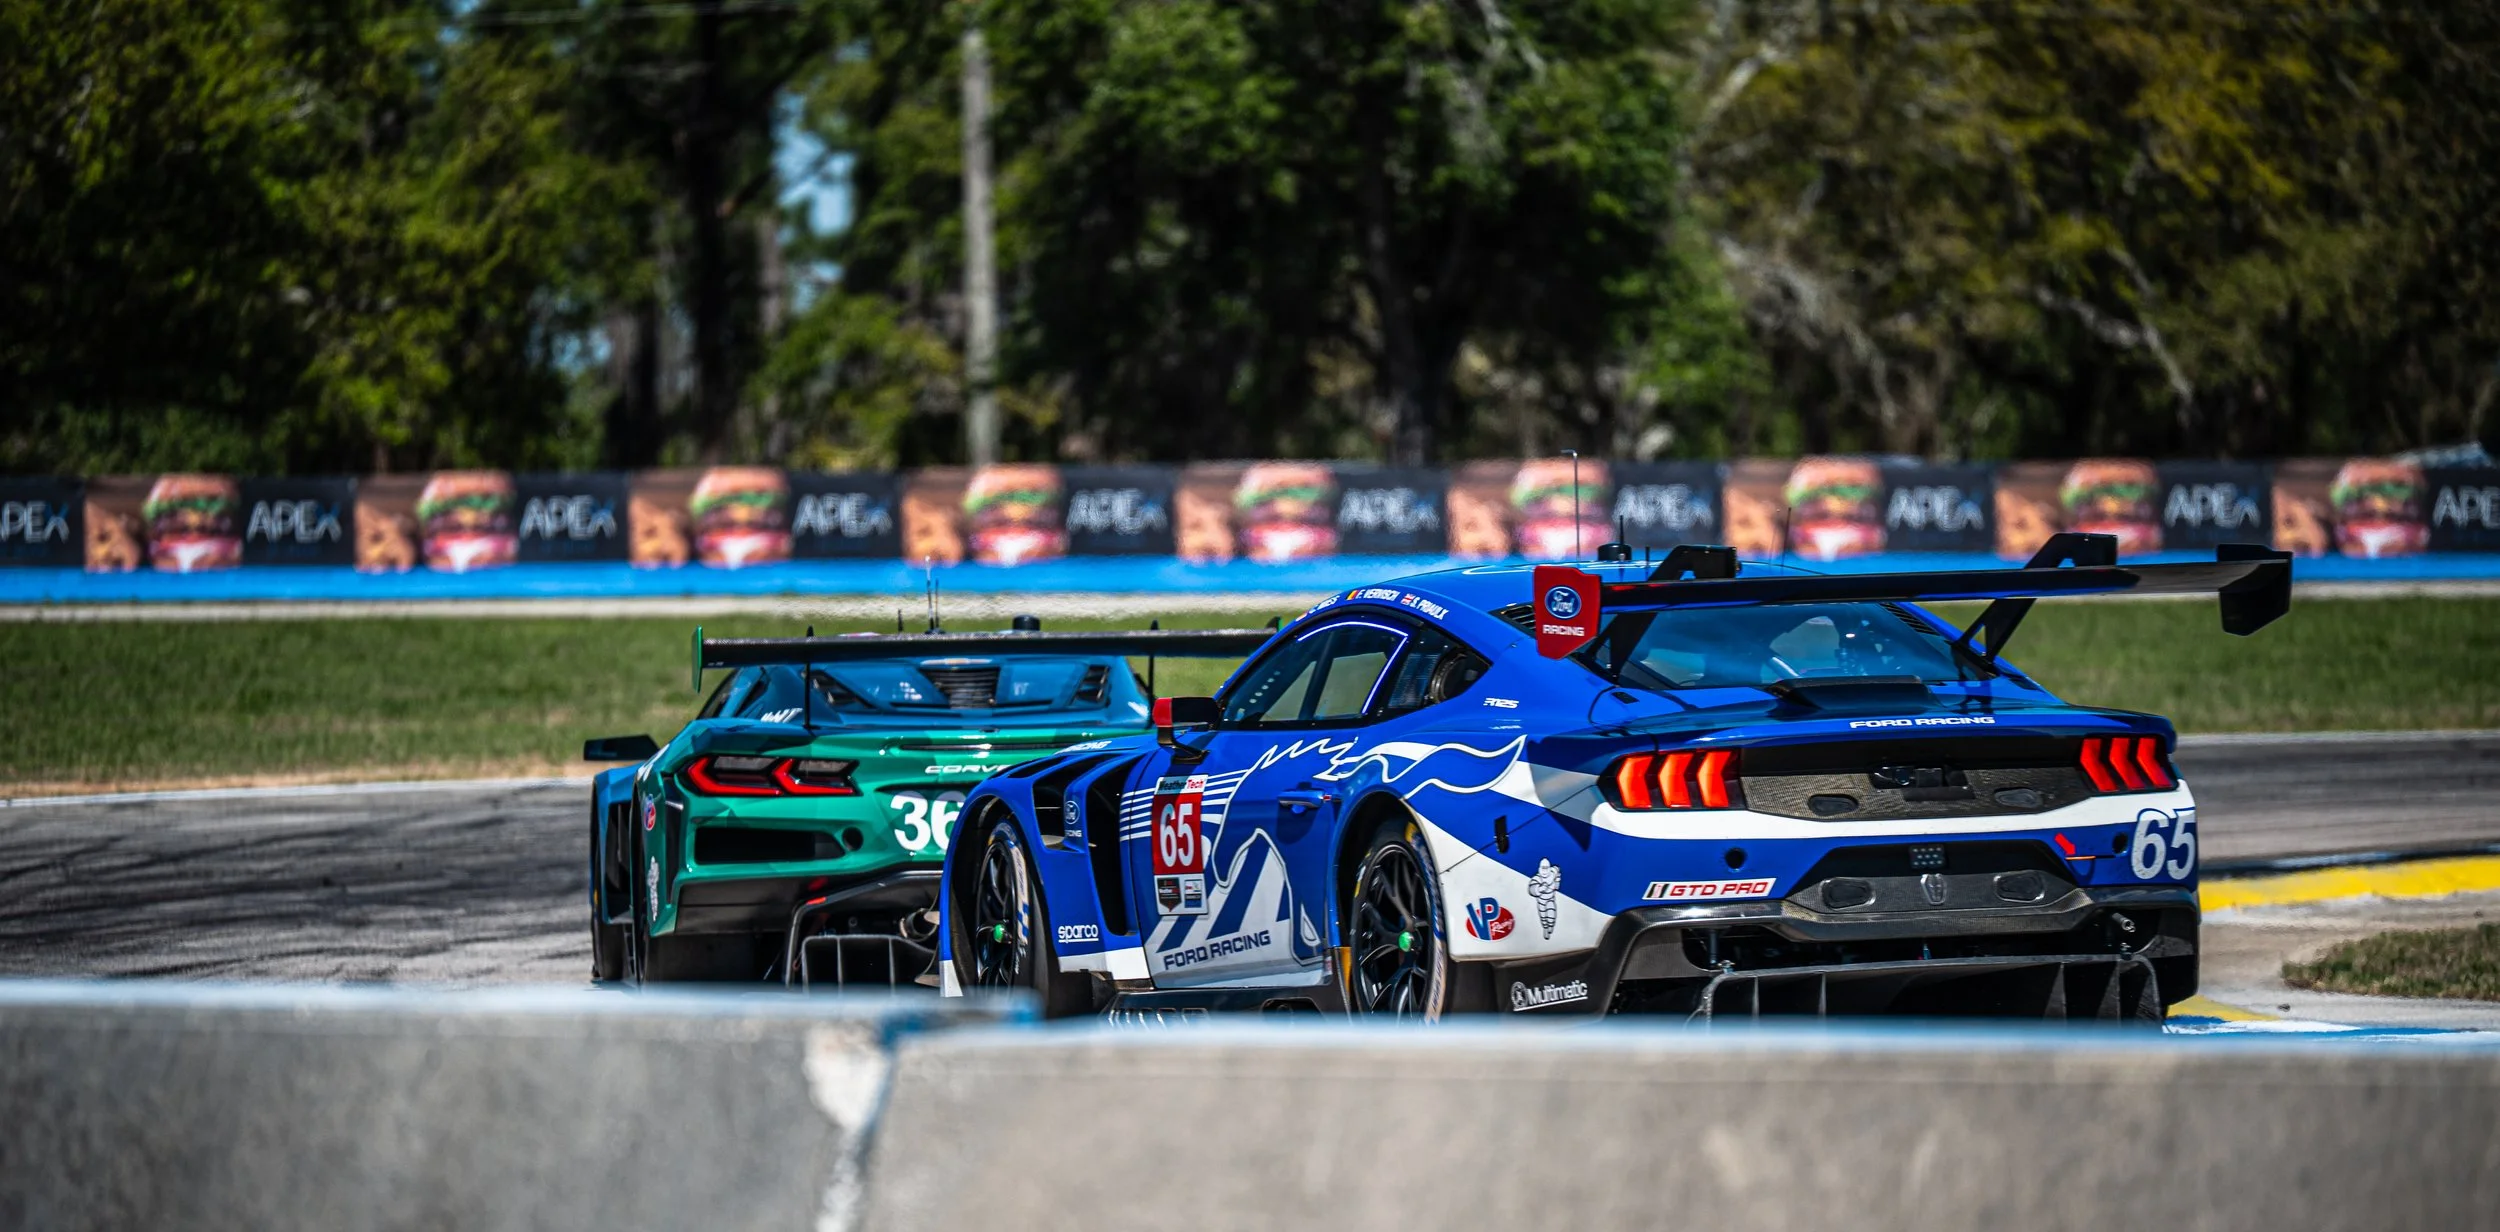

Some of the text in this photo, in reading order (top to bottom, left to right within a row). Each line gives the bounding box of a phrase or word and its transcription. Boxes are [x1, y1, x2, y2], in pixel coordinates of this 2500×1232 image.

[247, 499, 342, 543] APEX
[520, 494, 617, 540] APEX
[2164, 483, 2261, 528] APEX
[1550, 589, 1577, 614] Ford
[1543, 624, 1585, 637] RACING
[1850, 716, 1995, 728] FORD RACING
[891, 790, 967, 851] 36
[1160, 803, 1195, 868] 65
[2131, 807, 2196, 880] 65
[1670, 882, 1768, 897] GTD PRO
[1058, 924, 1099, 942] sparco
[1466, 897, 1499, 940] VP
[1163, 930, 1271, 970] FORD RACING
[1527, 980, 1588, 1005] Multimatic
